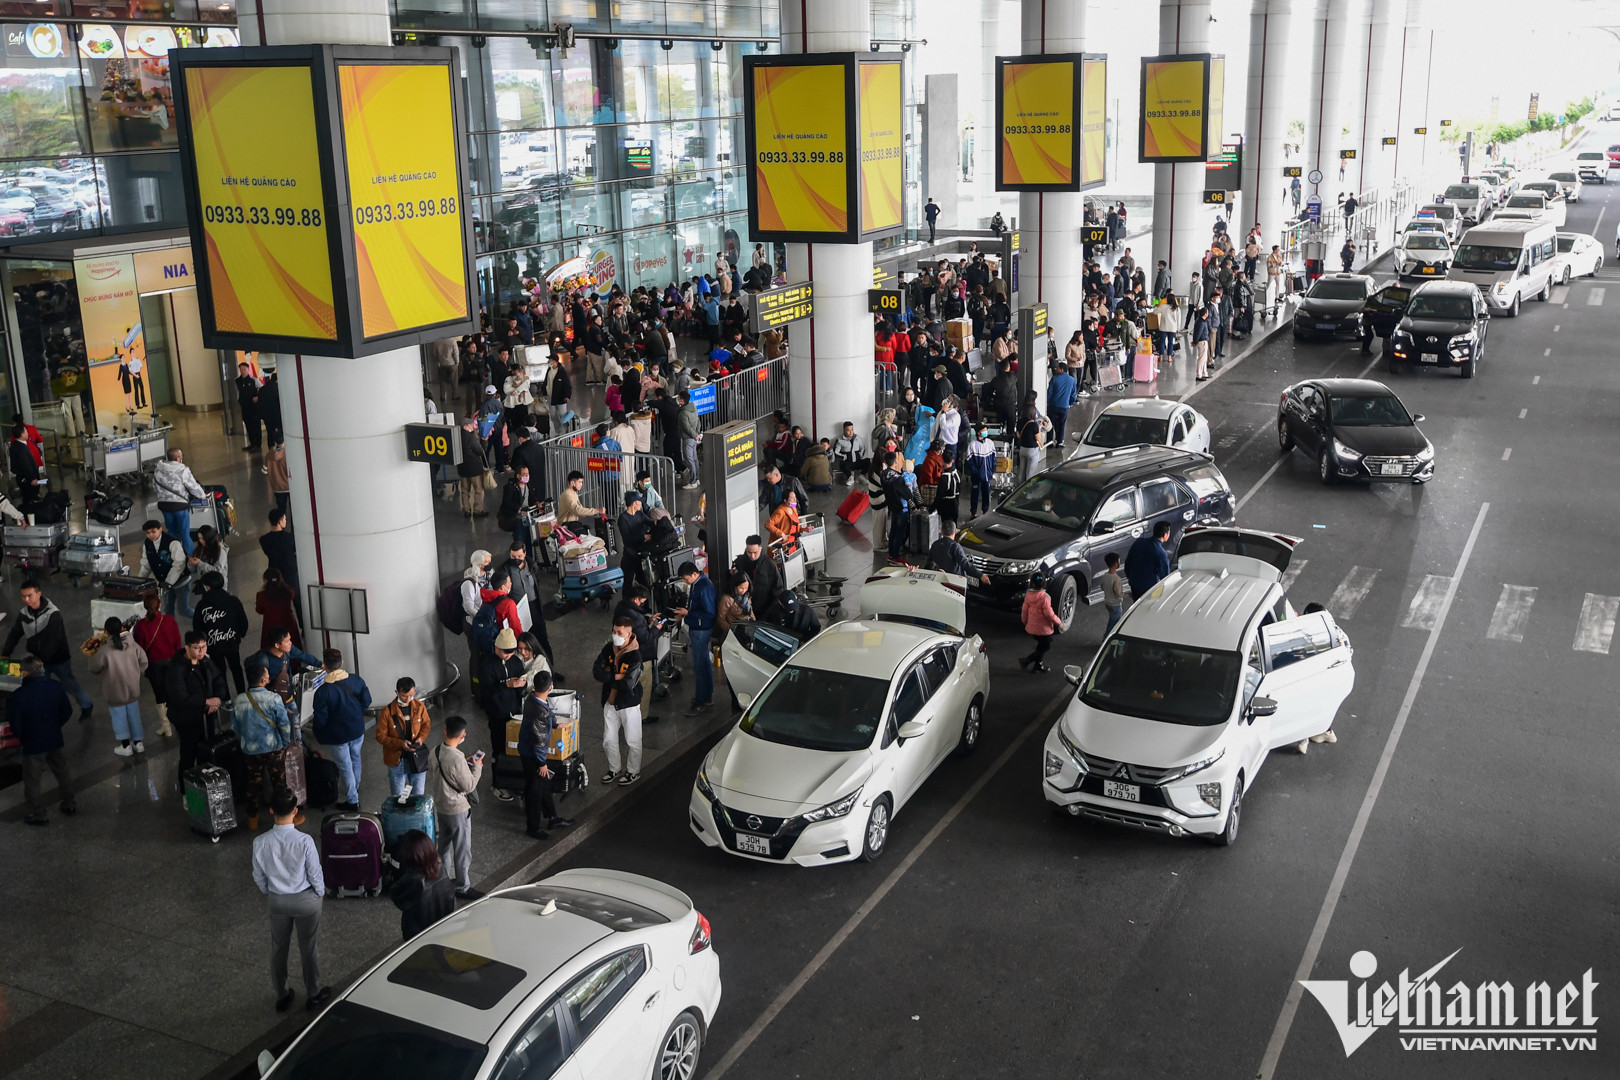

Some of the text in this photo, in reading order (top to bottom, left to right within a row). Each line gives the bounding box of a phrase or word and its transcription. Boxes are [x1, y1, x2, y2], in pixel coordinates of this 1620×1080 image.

[1147, 110, 1200, 118] 0933.33.99.88
[1005, 125, 1071, 134] 0933.33.99.88
[760, 151, 844, 163] 0933.33.99.88
[862, 146, 900, 162] 0933.33.99.88
[221, 176, 238, 186] LIÊN
[240, 176, 250, 188] HỆ
[371, 174, 387, 184] LIÊN
[388, 173, 398, 184] HỆ
[1211, 193, 1223, 202] 06
[205, 205, 322, 227] 0933.33.99.88
[355, 197, 456, 225] 0933.33.99.88
[1090, 230, 1104, 241] 07
[163, 263, 189, 279] NIA
[881, 295, 898, 308] 08
[412, 435, 448, 457] 1F 09
[1114, 782, 1130, 792] 30G
[1107, 789, 1136, 801] 979.70
[746, 835, 760, 844] 30H
[740, 842, 767, 854] 539.78
